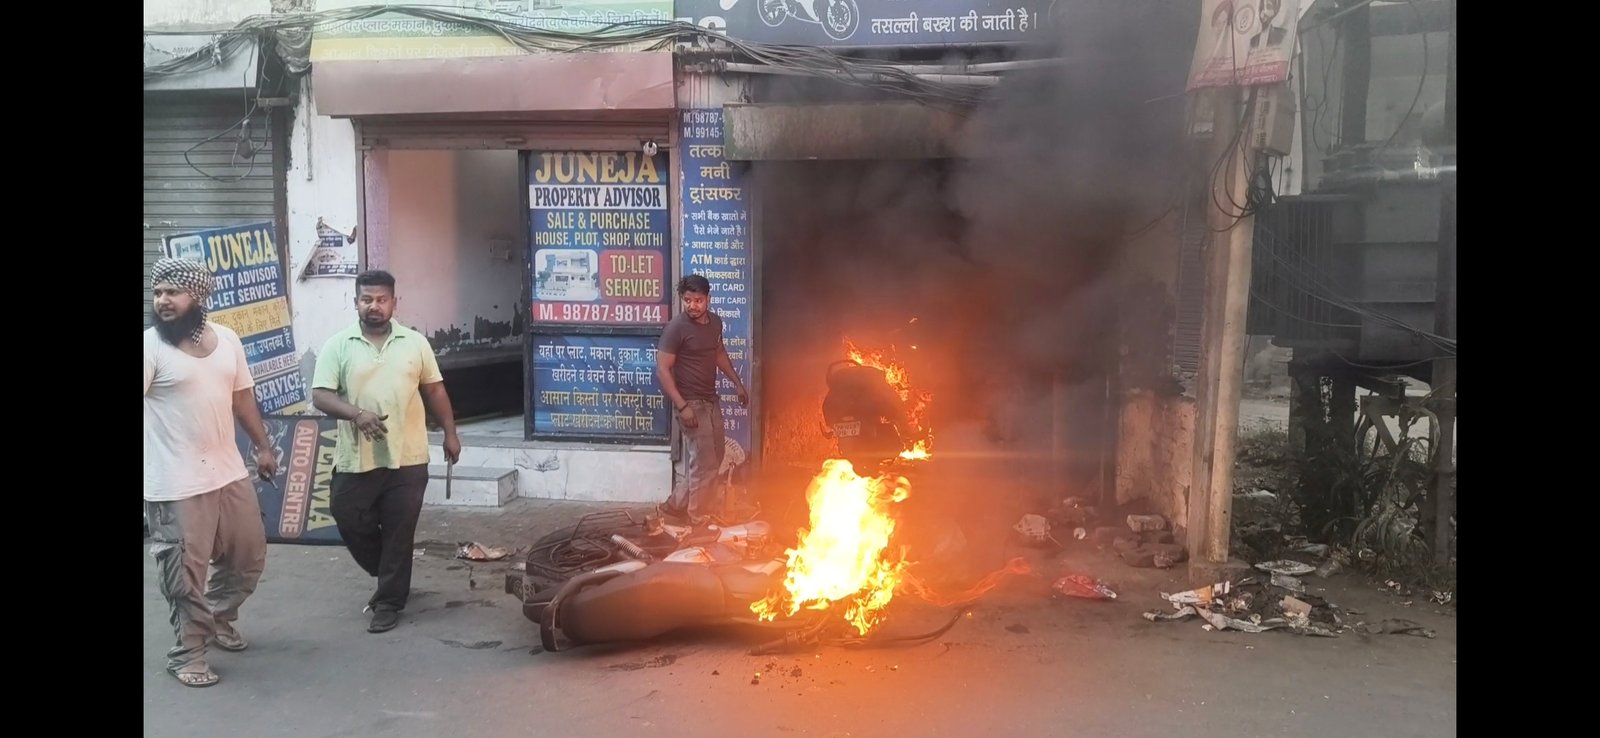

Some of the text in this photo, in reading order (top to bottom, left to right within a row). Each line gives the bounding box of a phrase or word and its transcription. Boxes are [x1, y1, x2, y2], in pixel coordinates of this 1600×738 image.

[871, 11, 919, 33] तसल्ली
[960, 9, 978, 31] की
[982, 8, 1015, 31] जाती
[536, 151, 659, 183] JUNEJA
[700, 162, 730, 179] मनी
[535, 186, 662, 207] PROPERTY ADVISOR
[689, 183, 742, 204] ट्रांसफर
[547, 212, 650, 230] SALE & PURCHASE
[535, 232, 663, 248] HOUSE, PLOT, SHOP, KOTHI
[207, 230, 278, 273] JUNEJA
[690, 254, 712, 264] ATM
[610, 255, 654, 274] TO-LET
[237, 266, 278, 286] ADVISOR
[206, 282, 277, 310] O-LET SERVICE
[605, 279, 660, 298] SERVICE
[722, 283, 745, 292] CARD
[711, 296, 747, 305] EBIT CARD
[540, 303, 663, 322] M. 98787-98144
[538, 341, 554, 361] यहां
[556, 345, 566, 359] पर
[551, 363, 577, 383] खरीदने
[608, 364, 616, 383] के
[255, 371, 302, 402] SERVICE
[262, 400, 274, 413] 24
[274, 391, 301, 409] HOURS
[541, 390, 571, 406] आसान
[602, 392, 613, 407] पर
[615, 409, 633, 433] लिए
[281, 427, 314, 534] AUTO CENTRE
